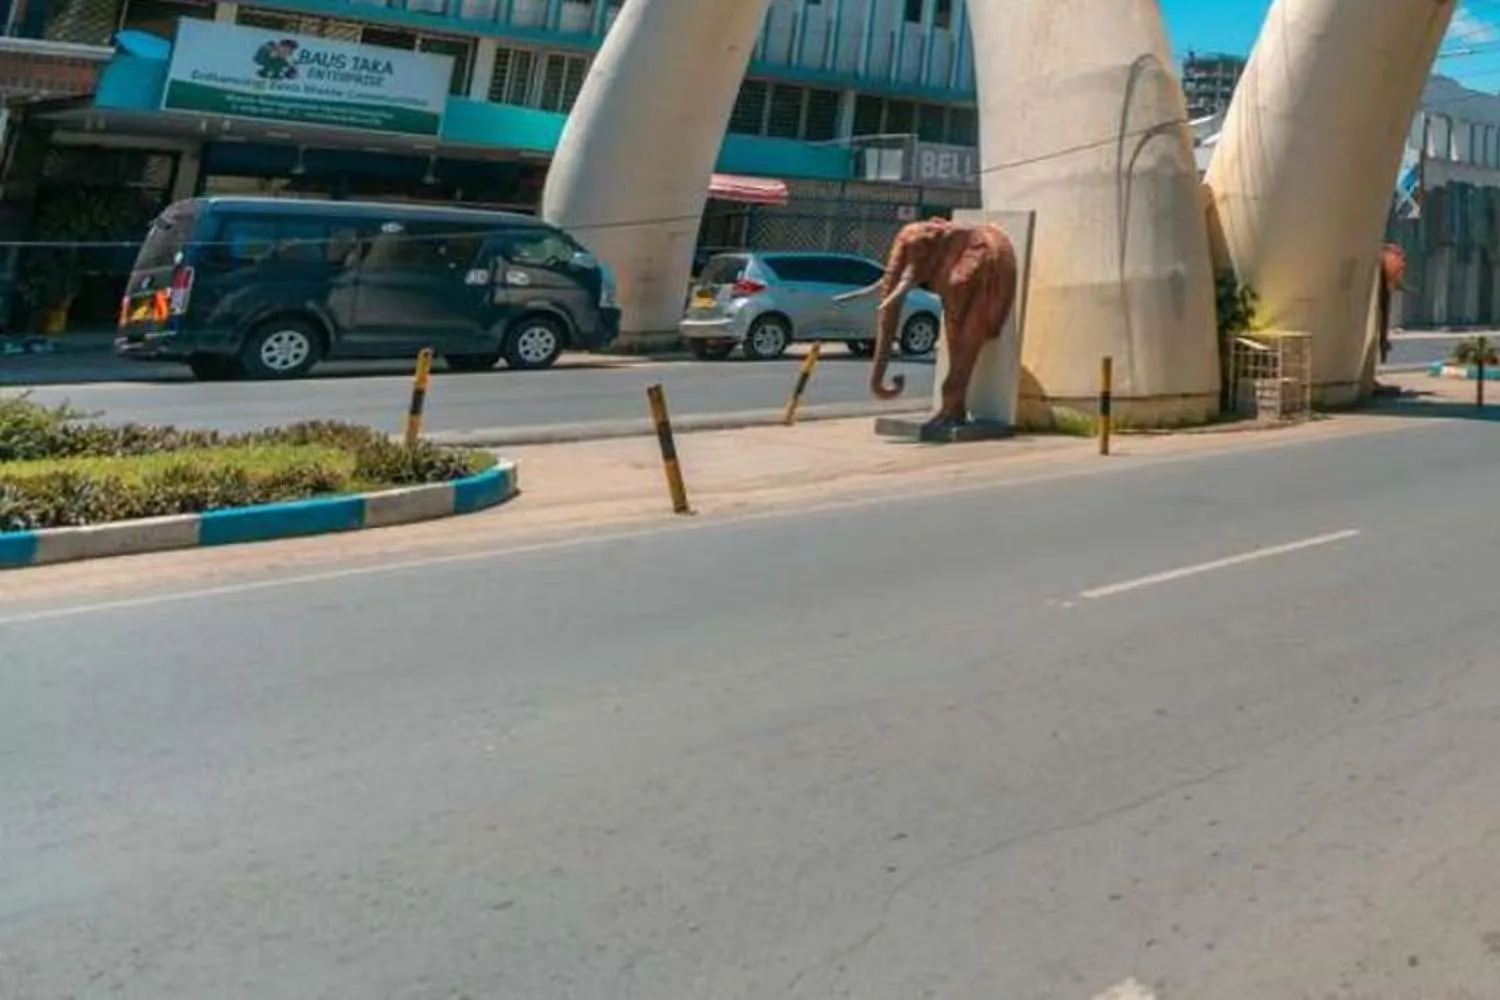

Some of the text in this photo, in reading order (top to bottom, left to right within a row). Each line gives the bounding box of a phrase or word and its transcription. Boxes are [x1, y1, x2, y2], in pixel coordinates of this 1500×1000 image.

[297, 49, 394, 75] BAUS TAKA
[306, 69, 386, 86] ENTERPRISE
